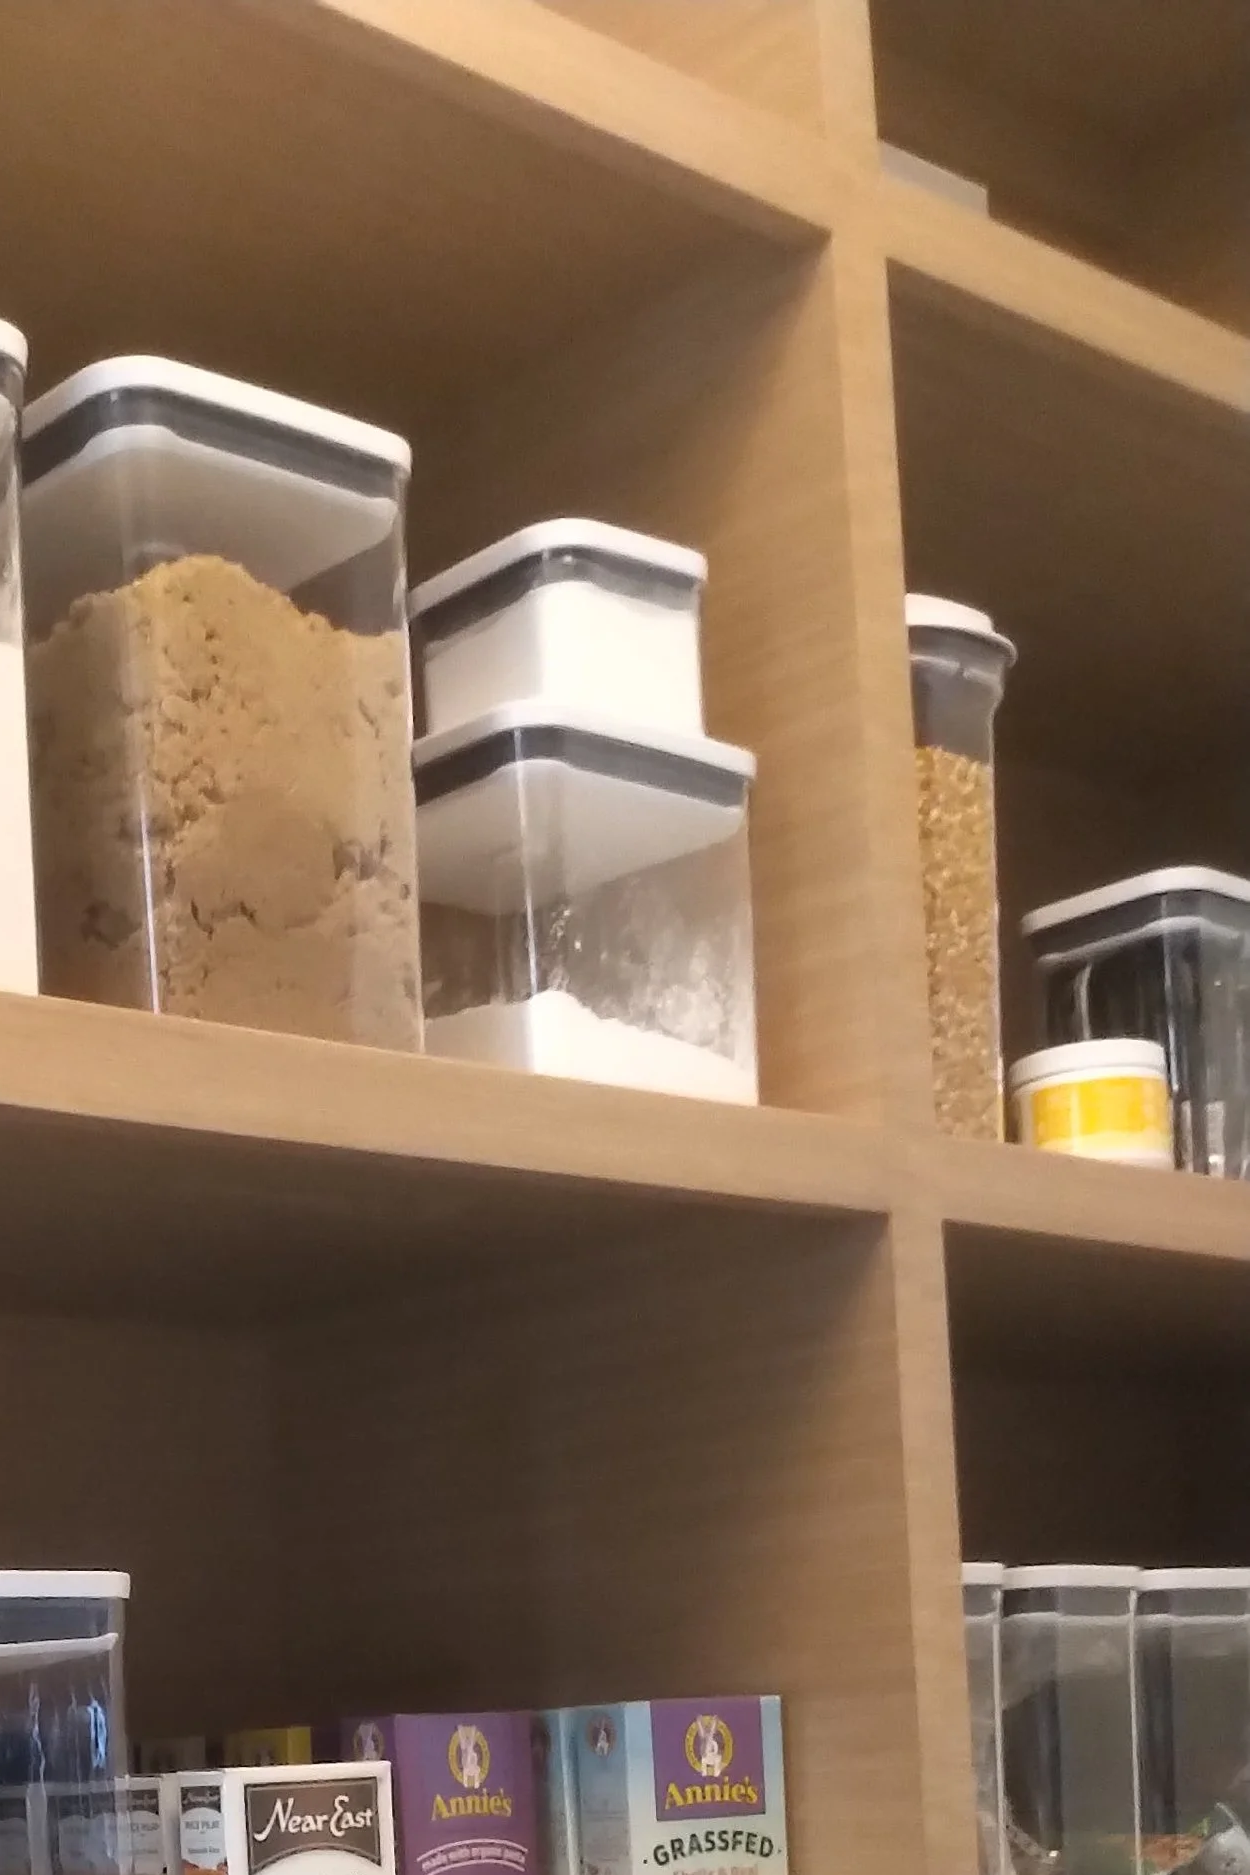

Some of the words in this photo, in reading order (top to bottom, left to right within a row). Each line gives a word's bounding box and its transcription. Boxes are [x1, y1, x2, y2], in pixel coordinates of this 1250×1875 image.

[431, 1787, 512, 1821] Annie's
[665, 1776, 758, 1810] Annie's
[253, 1797, 328, 1841] Near
[329, 1795, 373, 1837] East
[652, 1830, 774, 1866] GRASSFED
